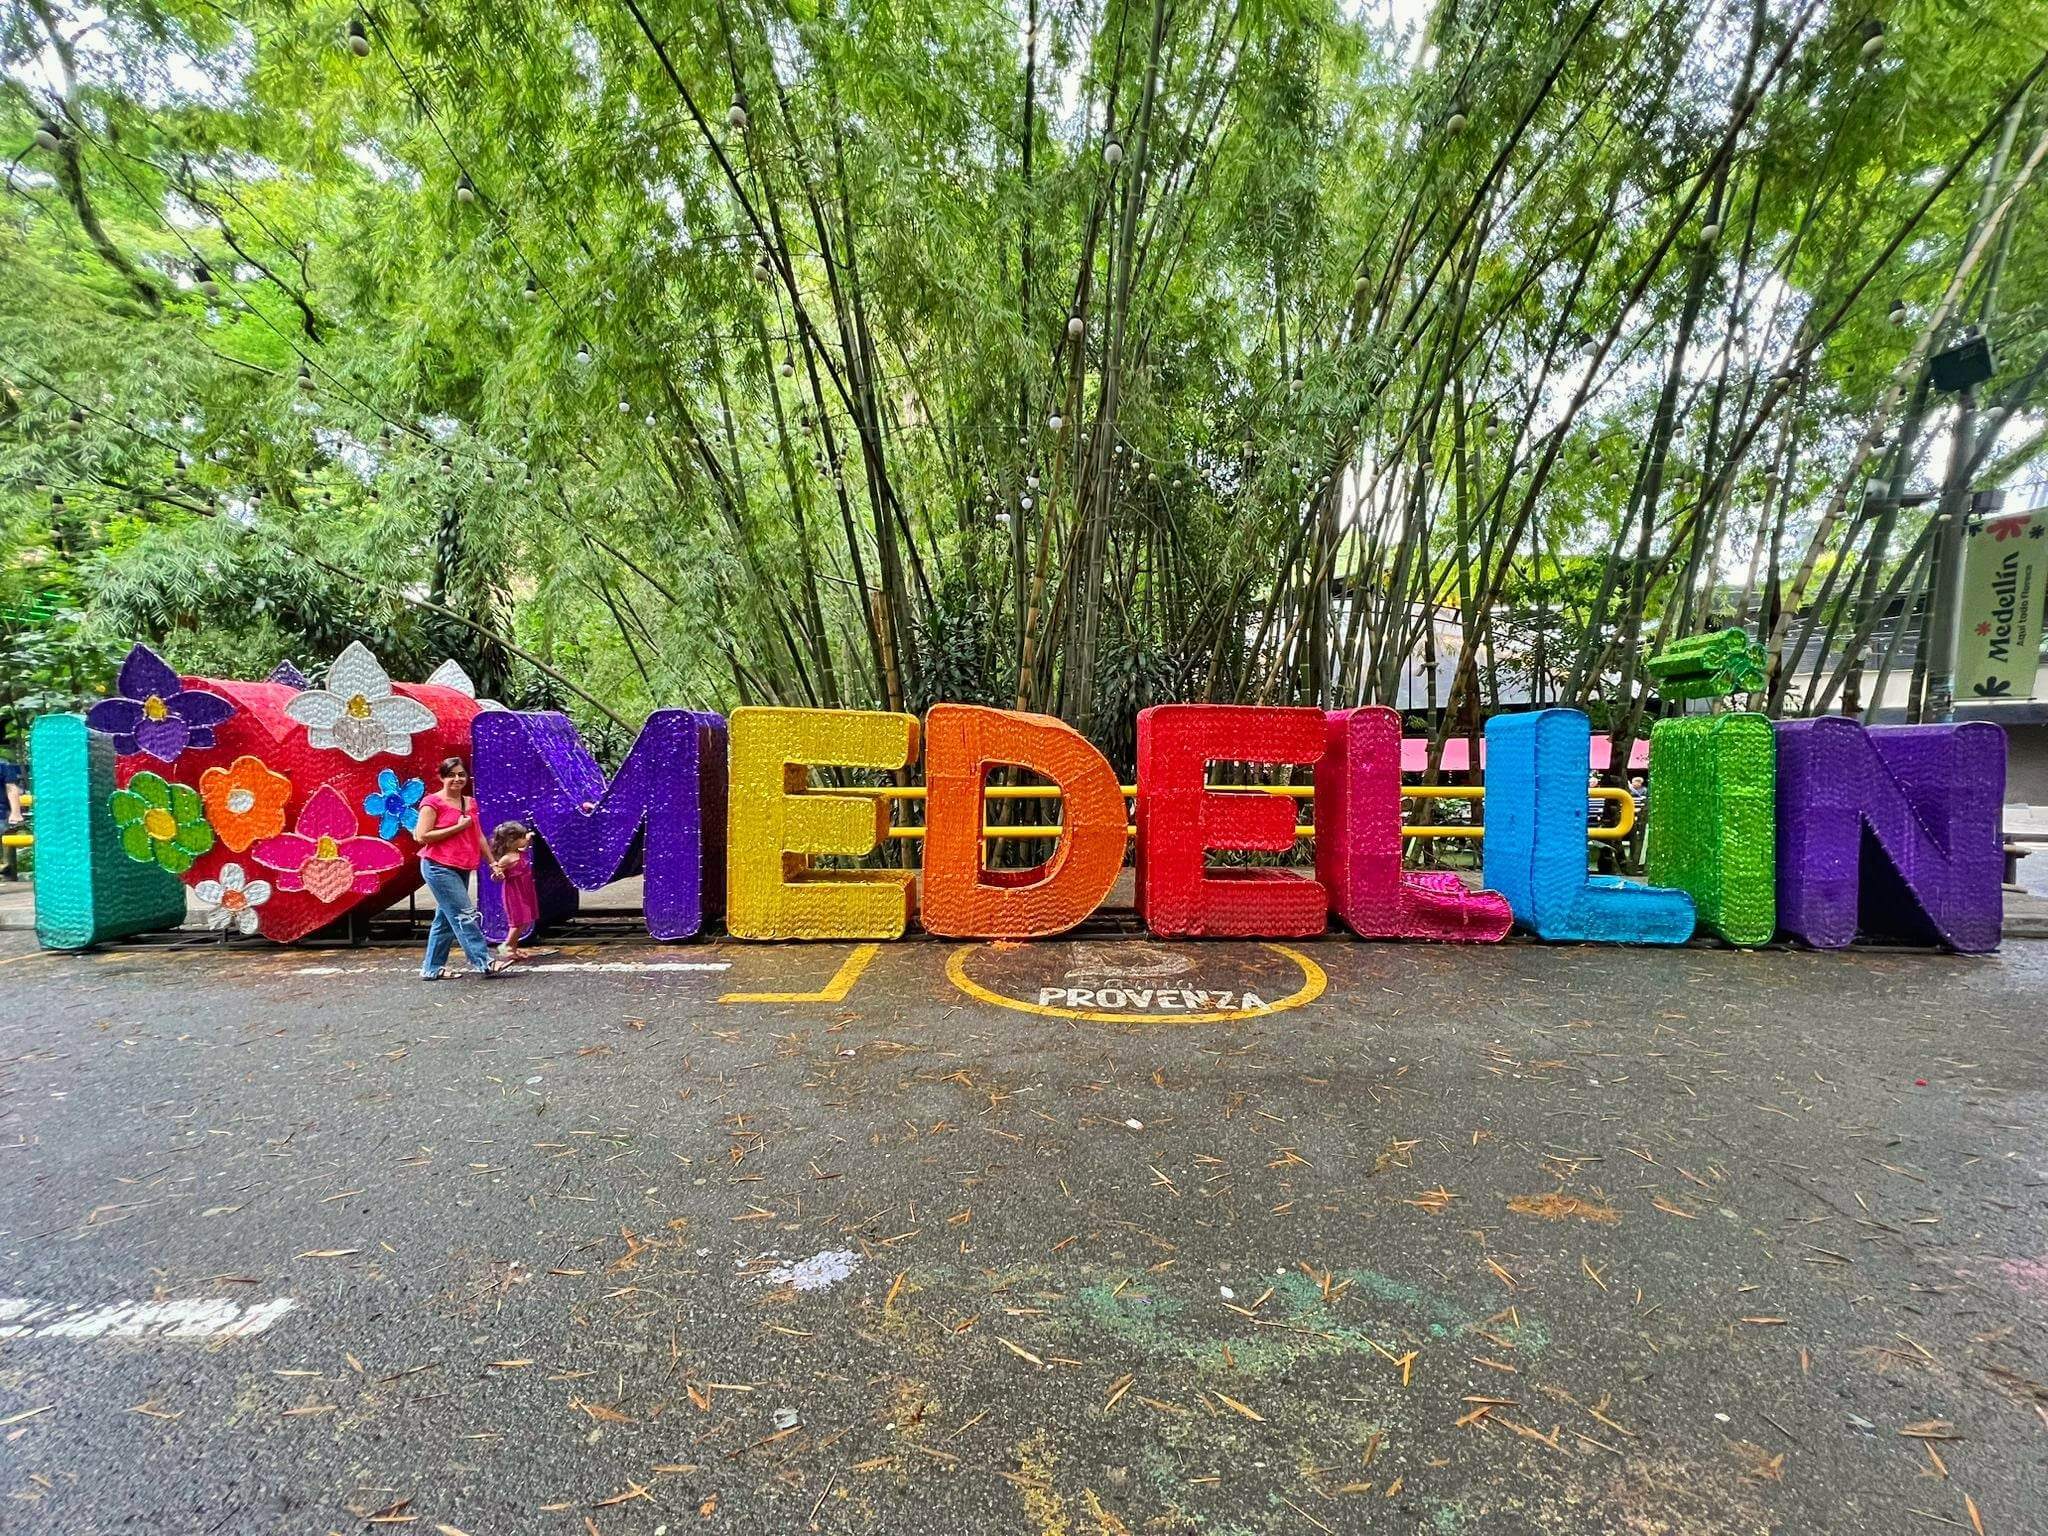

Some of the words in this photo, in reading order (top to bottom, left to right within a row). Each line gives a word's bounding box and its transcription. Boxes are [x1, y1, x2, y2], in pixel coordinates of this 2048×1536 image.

[1987, 551, 2019, 663] Medellín
[2018, 600, 2028, 623] todo
[2016, 625, 2027, 647] Aquí
[1038, 987, 1272, 1012] PROVENZA
